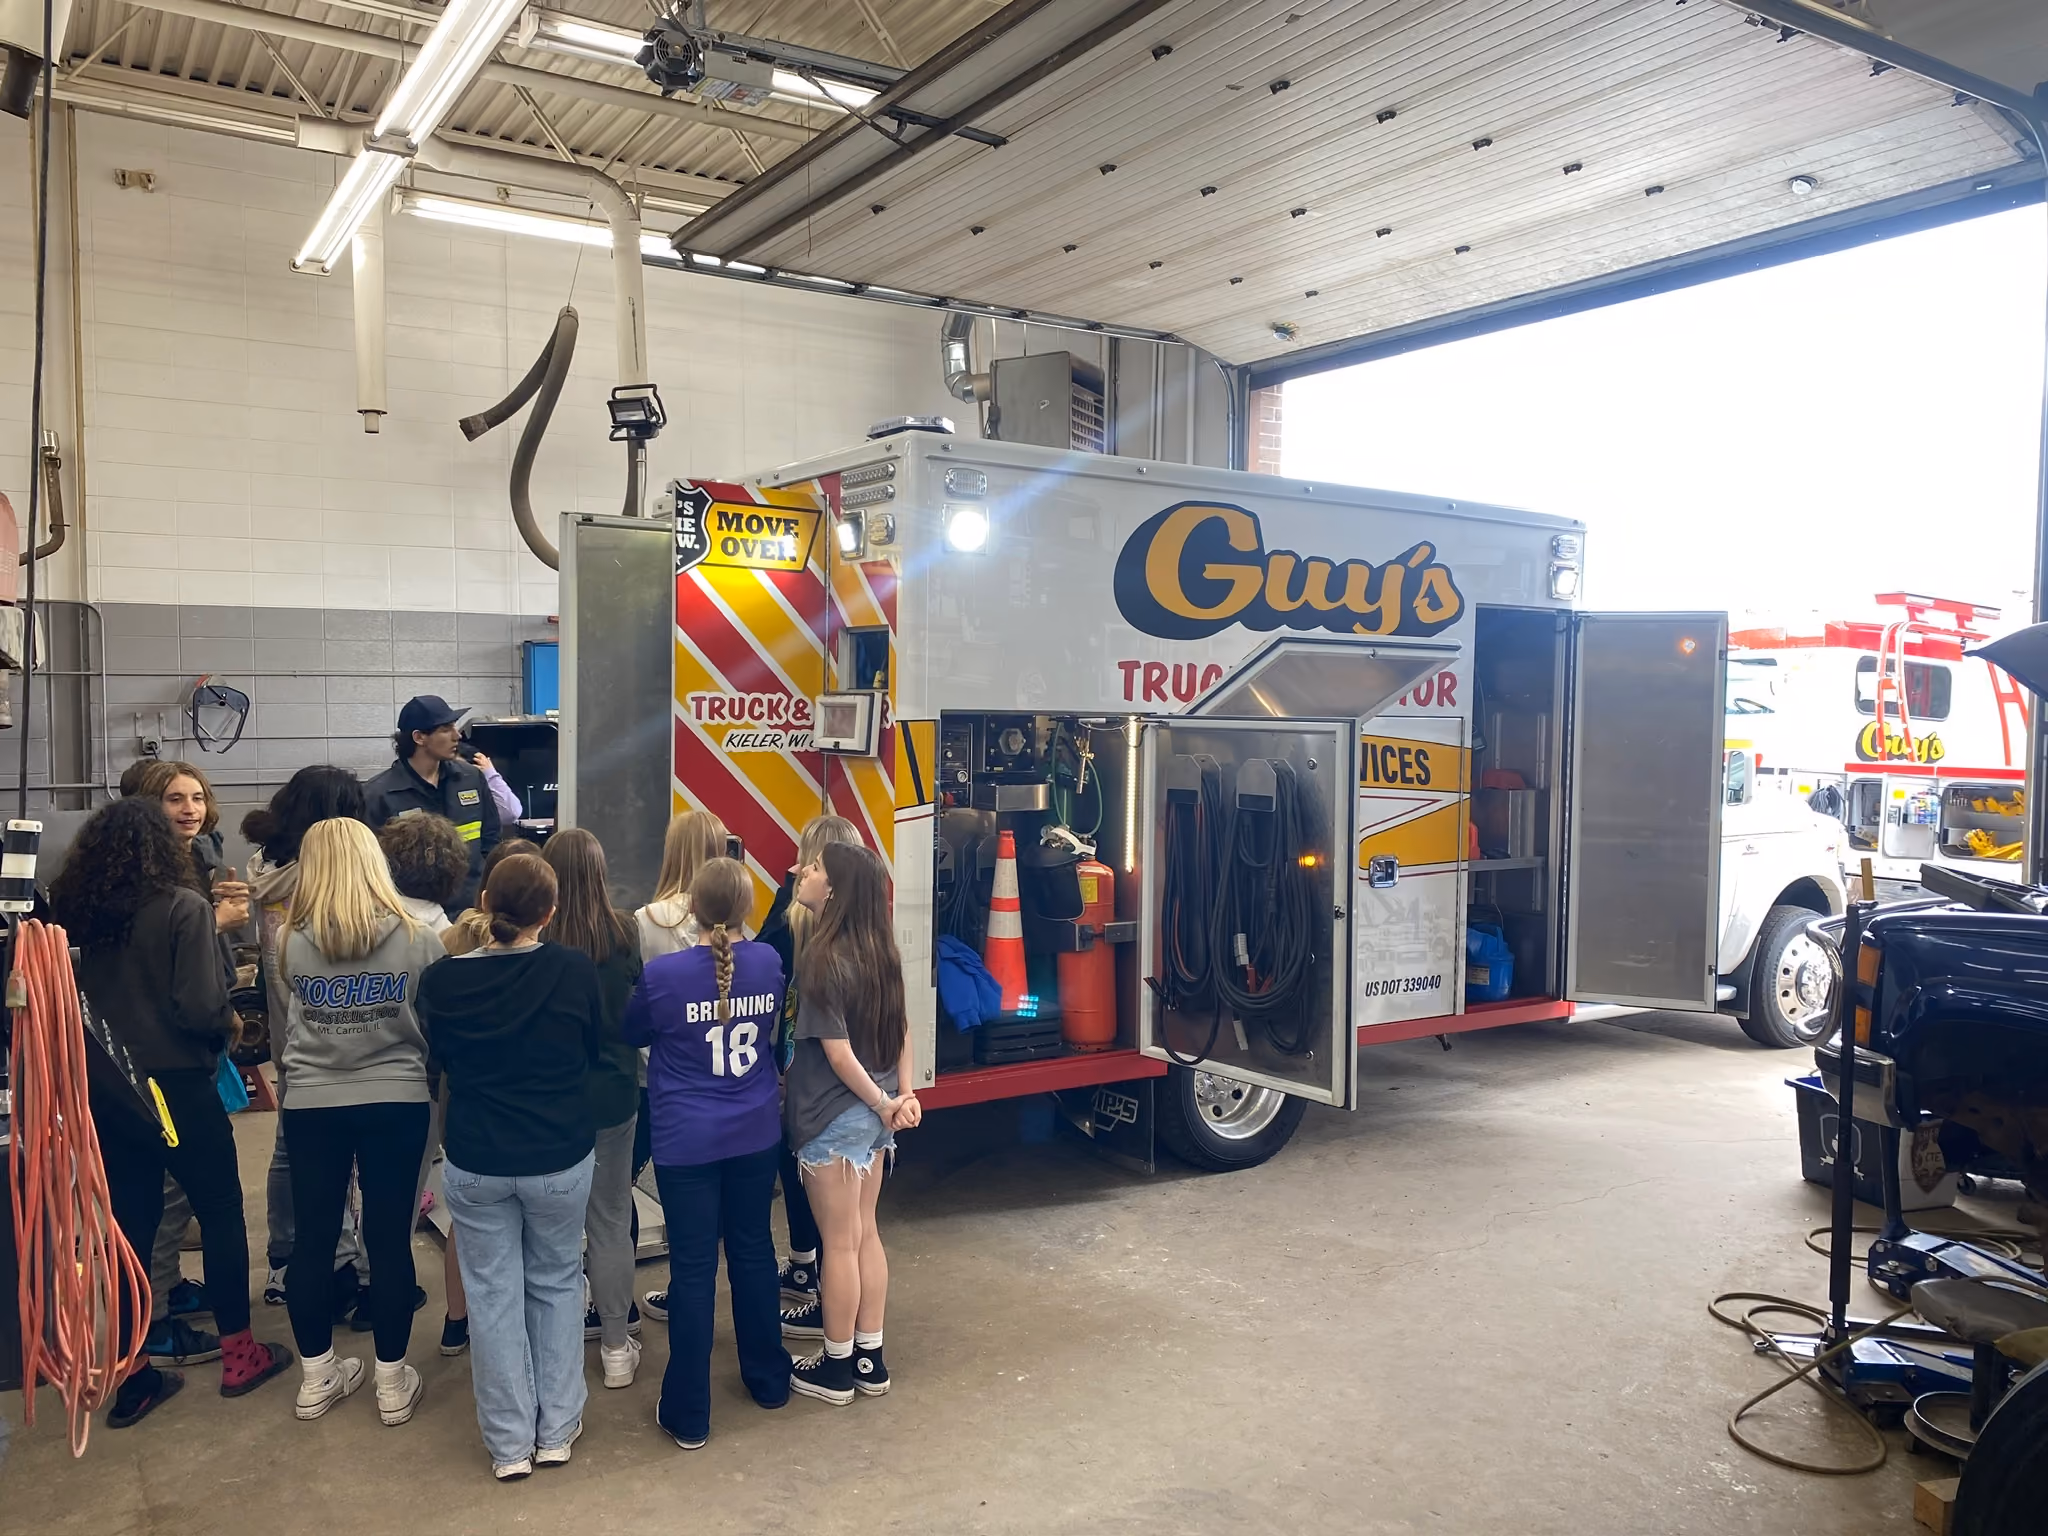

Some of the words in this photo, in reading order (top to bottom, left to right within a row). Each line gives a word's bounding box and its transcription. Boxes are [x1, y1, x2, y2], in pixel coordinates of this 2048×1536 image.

[716, 510, 800, 539] MOVE
[1114, 501, 1464, 640] Guy's
[1117, 659, 1223, 704] TRUC
[690, 696, 785, 721] TRUCK
[791, 699, 811, 720] &
[725, 732, 784, 750] KIELER,
[788, 733, 809, 748] WI
[1856, 720, 1946, 764] Guy's
[294, 971, 409, 1008] YOCHEM
[1365, 982, 1380, 997] US
[1381, 978, 1403, 996] DOT
[1403, 974, 1442, 993] 339040
[317, 1025, 333, 1035] Mt.
[705, 1021, 759, 1078] 18
